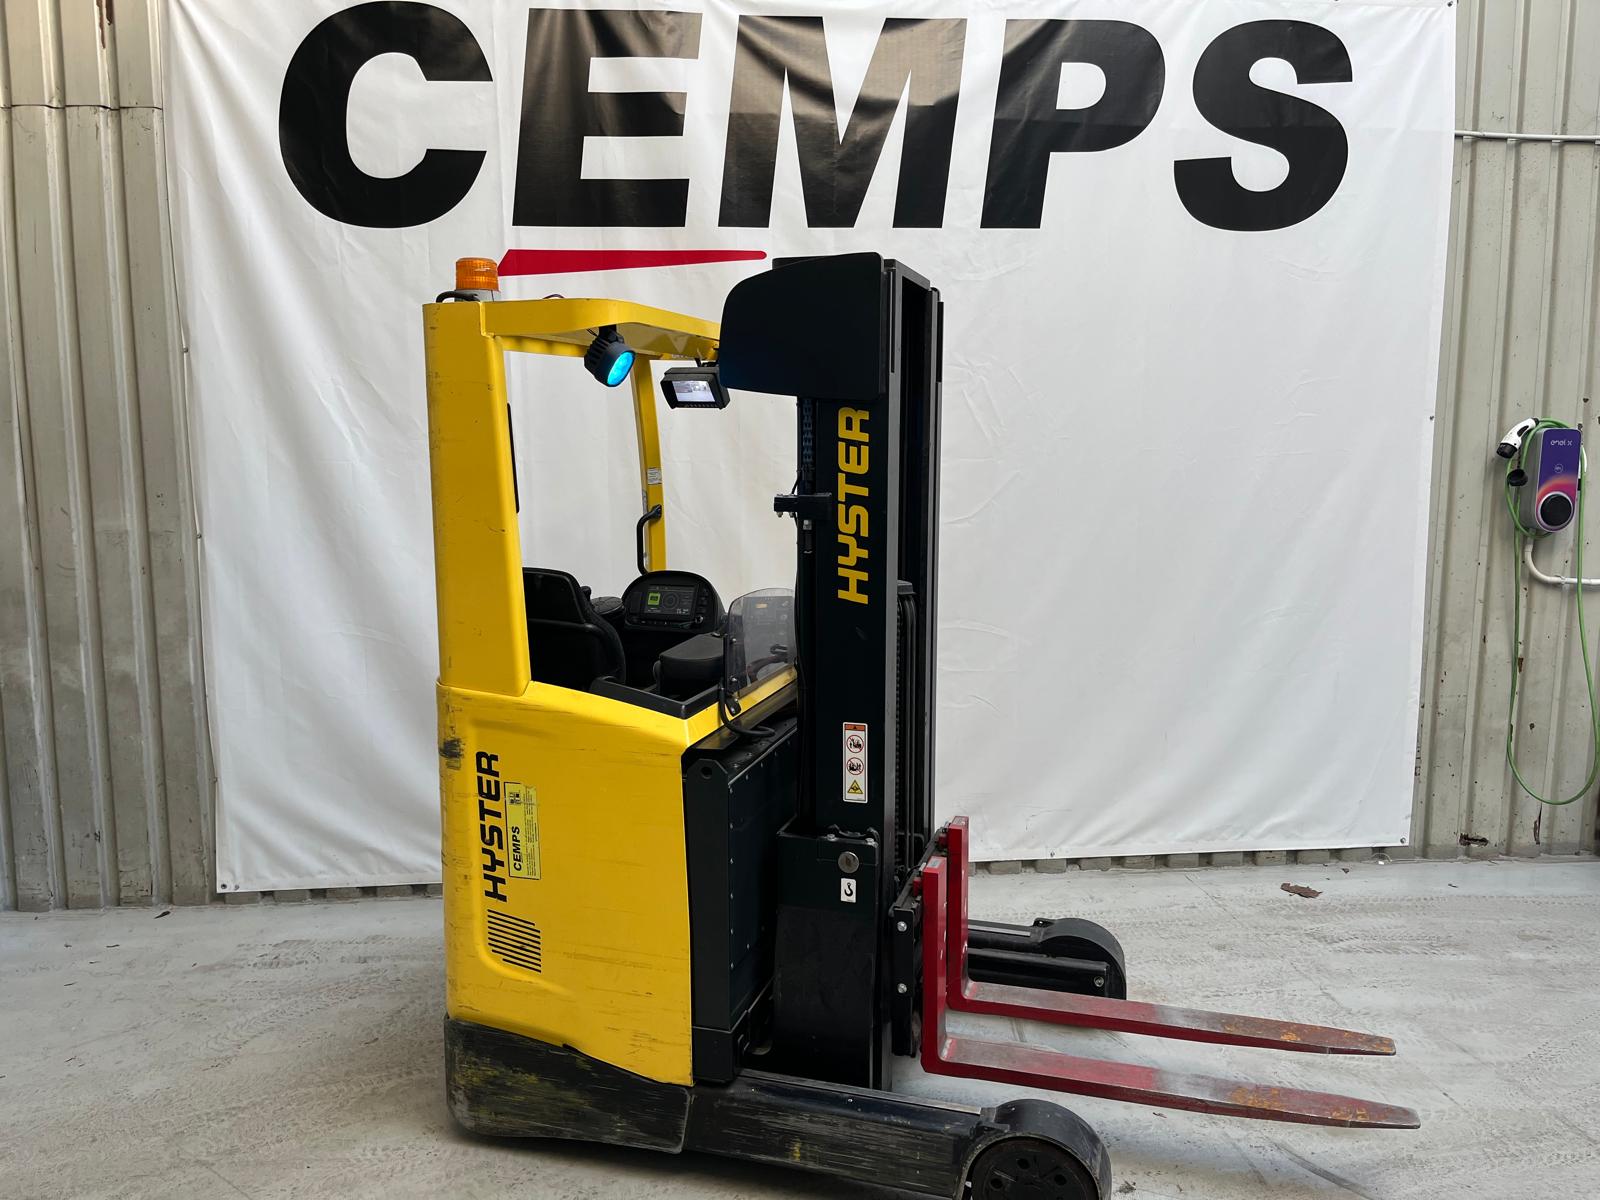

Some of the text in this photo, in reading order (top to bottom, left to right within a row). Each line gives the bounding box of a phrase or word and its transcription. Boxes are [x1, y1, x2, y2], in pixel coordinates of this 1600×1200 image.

[279, 1, 1353, 231] CEMPS
[838, 407, 870, 605] HYSTER
[476, 751, 507, 902] HYSTER
[512, 826, 522, 871] CEMPS
